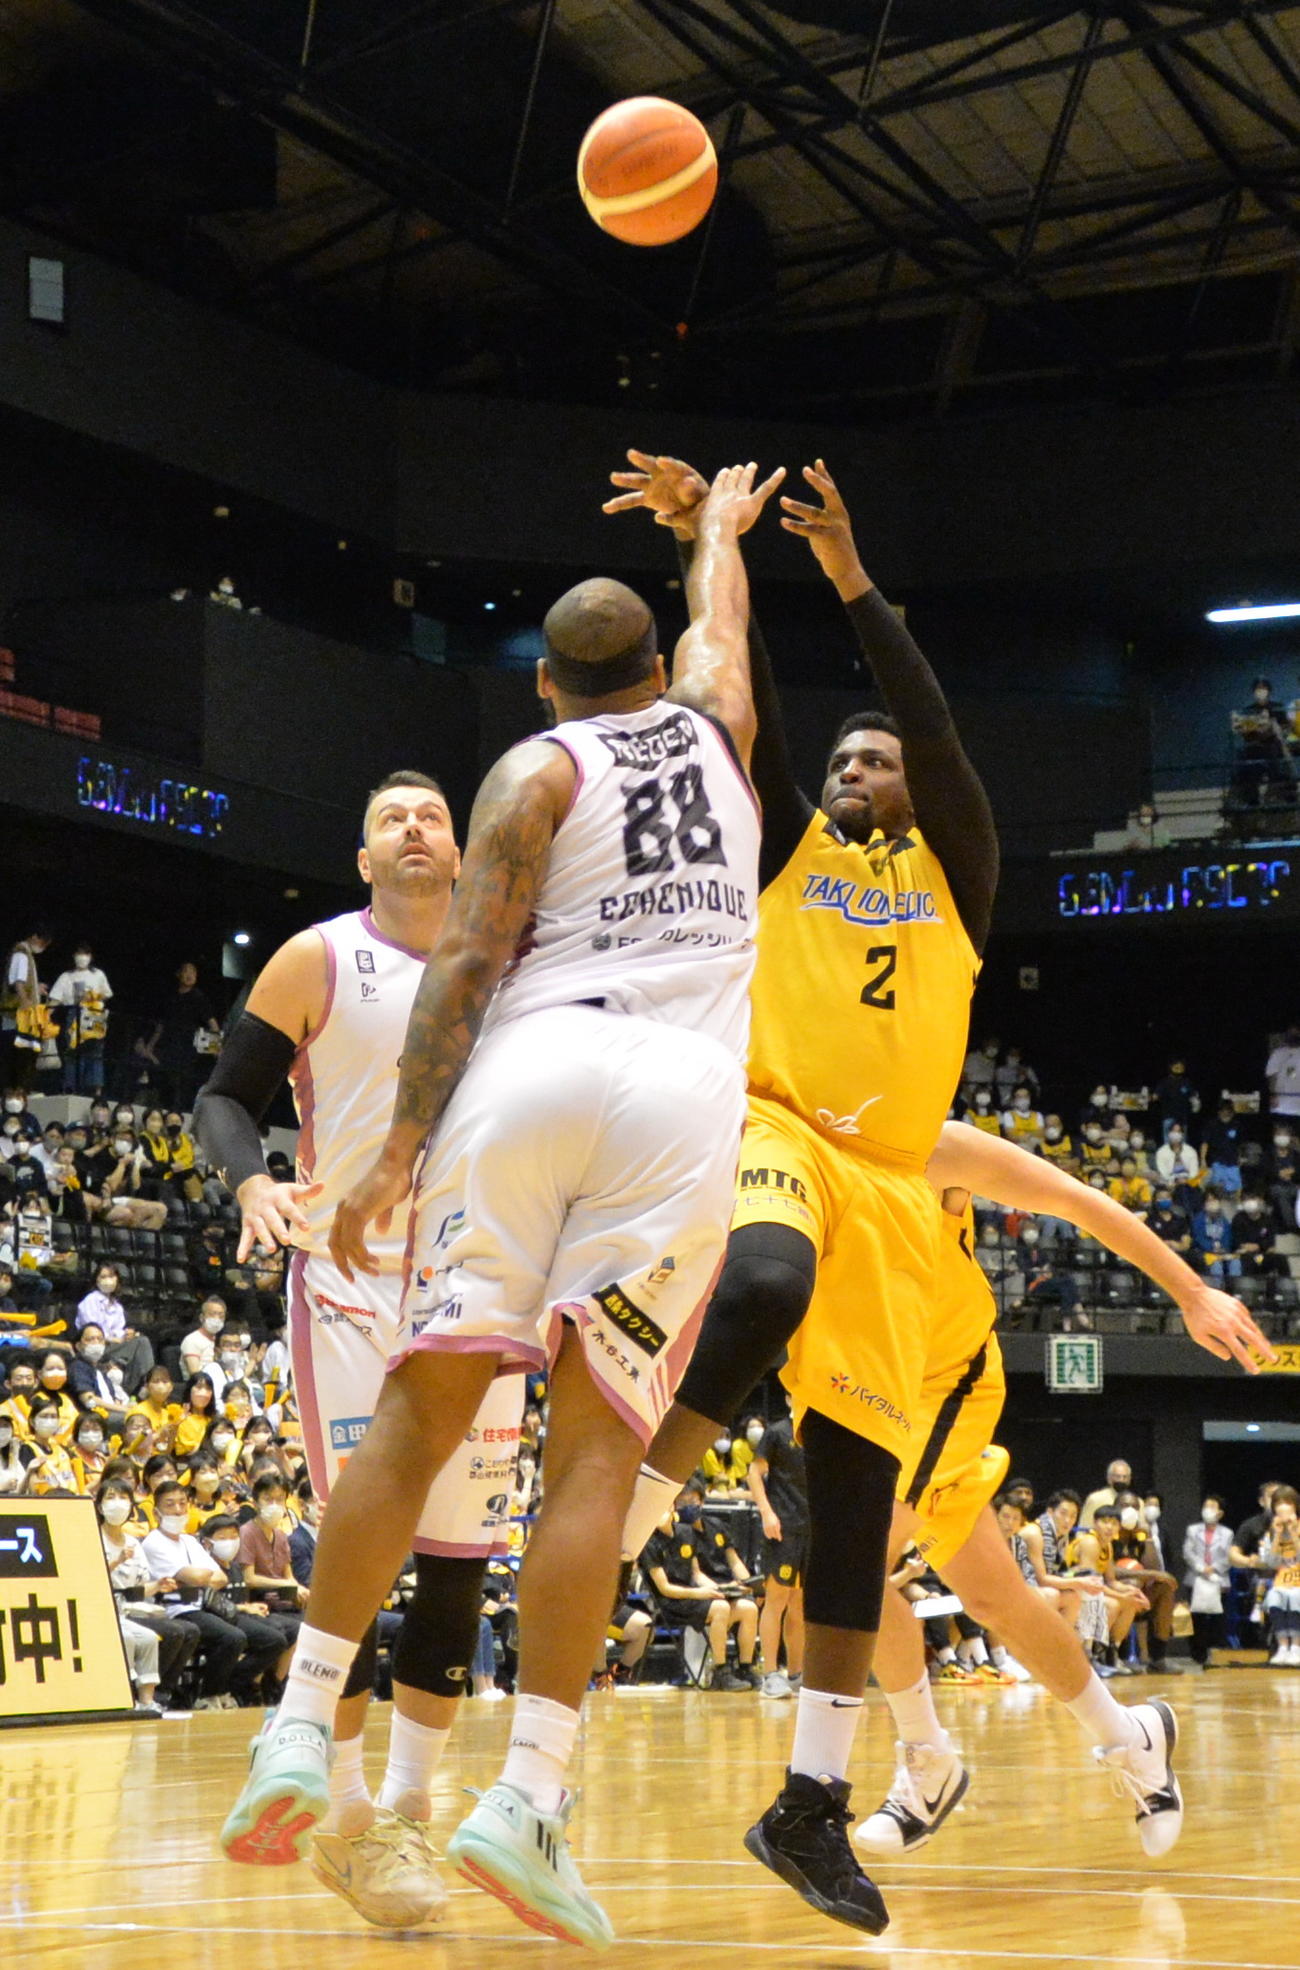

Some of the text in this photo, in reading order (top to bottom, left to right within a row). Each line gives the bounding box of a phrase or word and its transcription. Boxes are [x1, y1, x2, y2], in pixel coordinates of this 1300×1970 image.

[621, 765, 728, 877] 88
[860, 945, 897, 1011] 2
[0, 1592, 83, 1686] 中!
